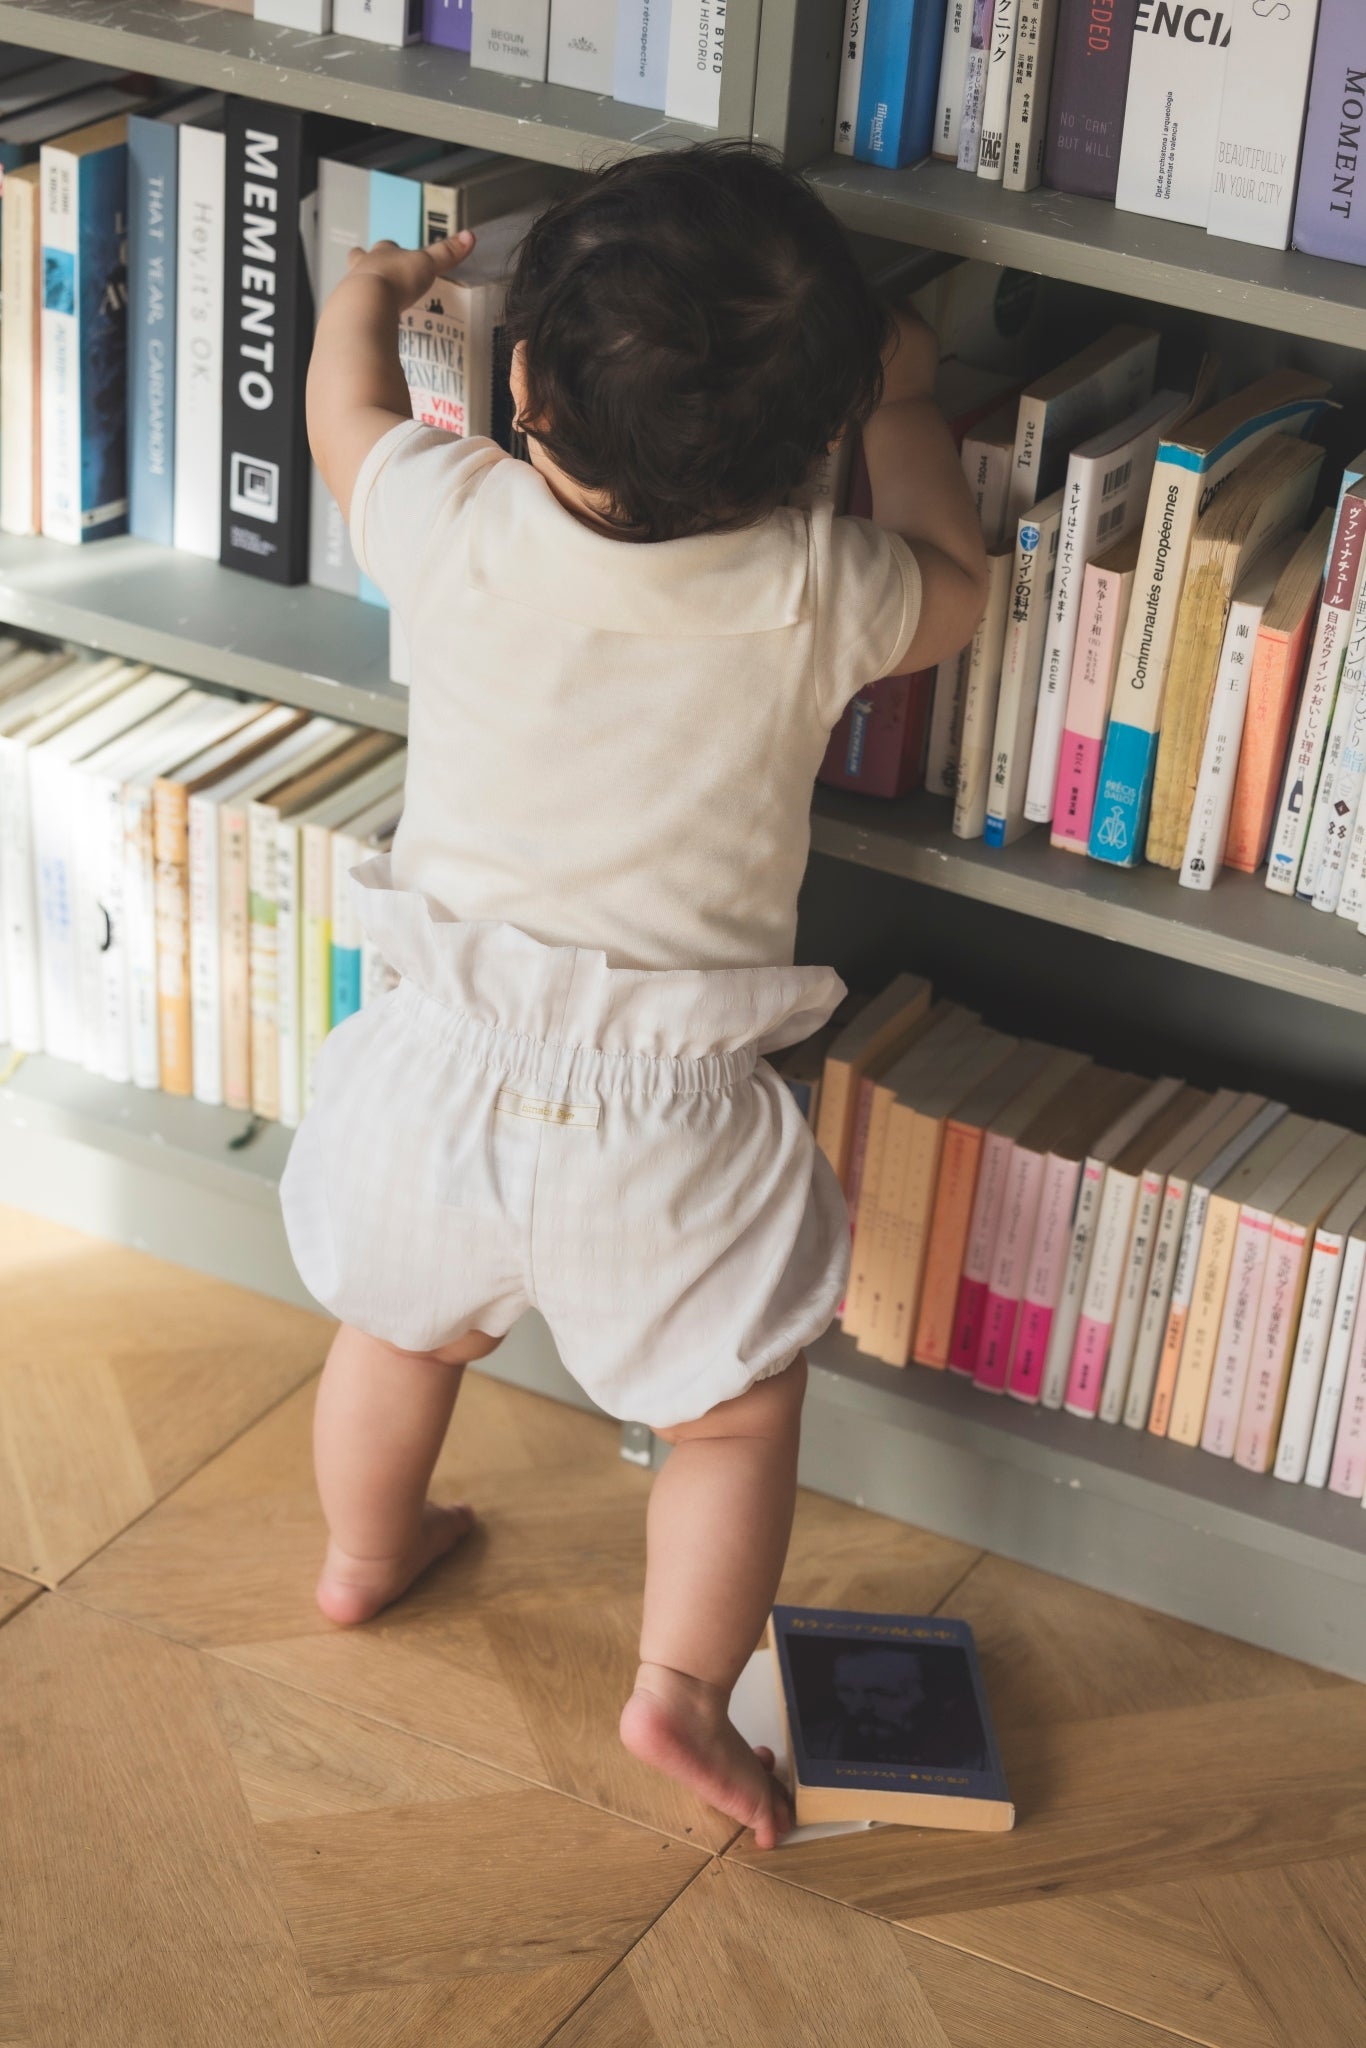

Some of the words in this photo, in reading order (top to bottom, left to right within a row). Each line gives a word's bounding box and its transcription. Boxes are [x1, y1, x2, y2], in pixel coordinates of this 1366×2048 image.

[487, 41, 501, 53] TO
[502, 44, 530, 57] THINK
[490, 29, 524, 44] BEGUN
[697, 8, 710, 71] HISTORIO
[712, 27, 725, 74] BYGD
[1060, 111, 1075, 128] NO
[1329, 67, 1366, 219] MOMENT
[981, 138, 1001, 161] TAC
[1057, 135, 1079, 149] BUT
[1085, 141, 1112, 158] WILL
[1217, 141, 1287, 175] BEAUTIFULLY
[1164, 162, 1174, 200] Universitat
[1214, 171, 1226, 193] IN
[1229, 176, 1256, 200] YOUR
[1257, 181, 1283, 206] CITY
[148, 175, 165, 242] THAT
[238, 128, 279, 411] MEMENTO
[424, 319, 465, 342] GUIDE
[148, 338, 165, 477] CARDAMOM
[432, 396, 465, 422] VINS
[1017, 421, 1036, 468] Tavae
[1056, 482, 1081, 624] キレイはこれでつくれます
[1013, 553, 1033, 623] ワインの科学
[1131, 584, 1163, 690] Communautés
[1154, 485, 1179, 582] européennes
[1047, 648, 1061, 695] MEGUMI
[1226, 622, 1249, 693] 蘭陵王
[1298, 610, 1339, 766] 自然なワインがおいしい理由
[1105, 780, 1137, 797] PRÉCIS
